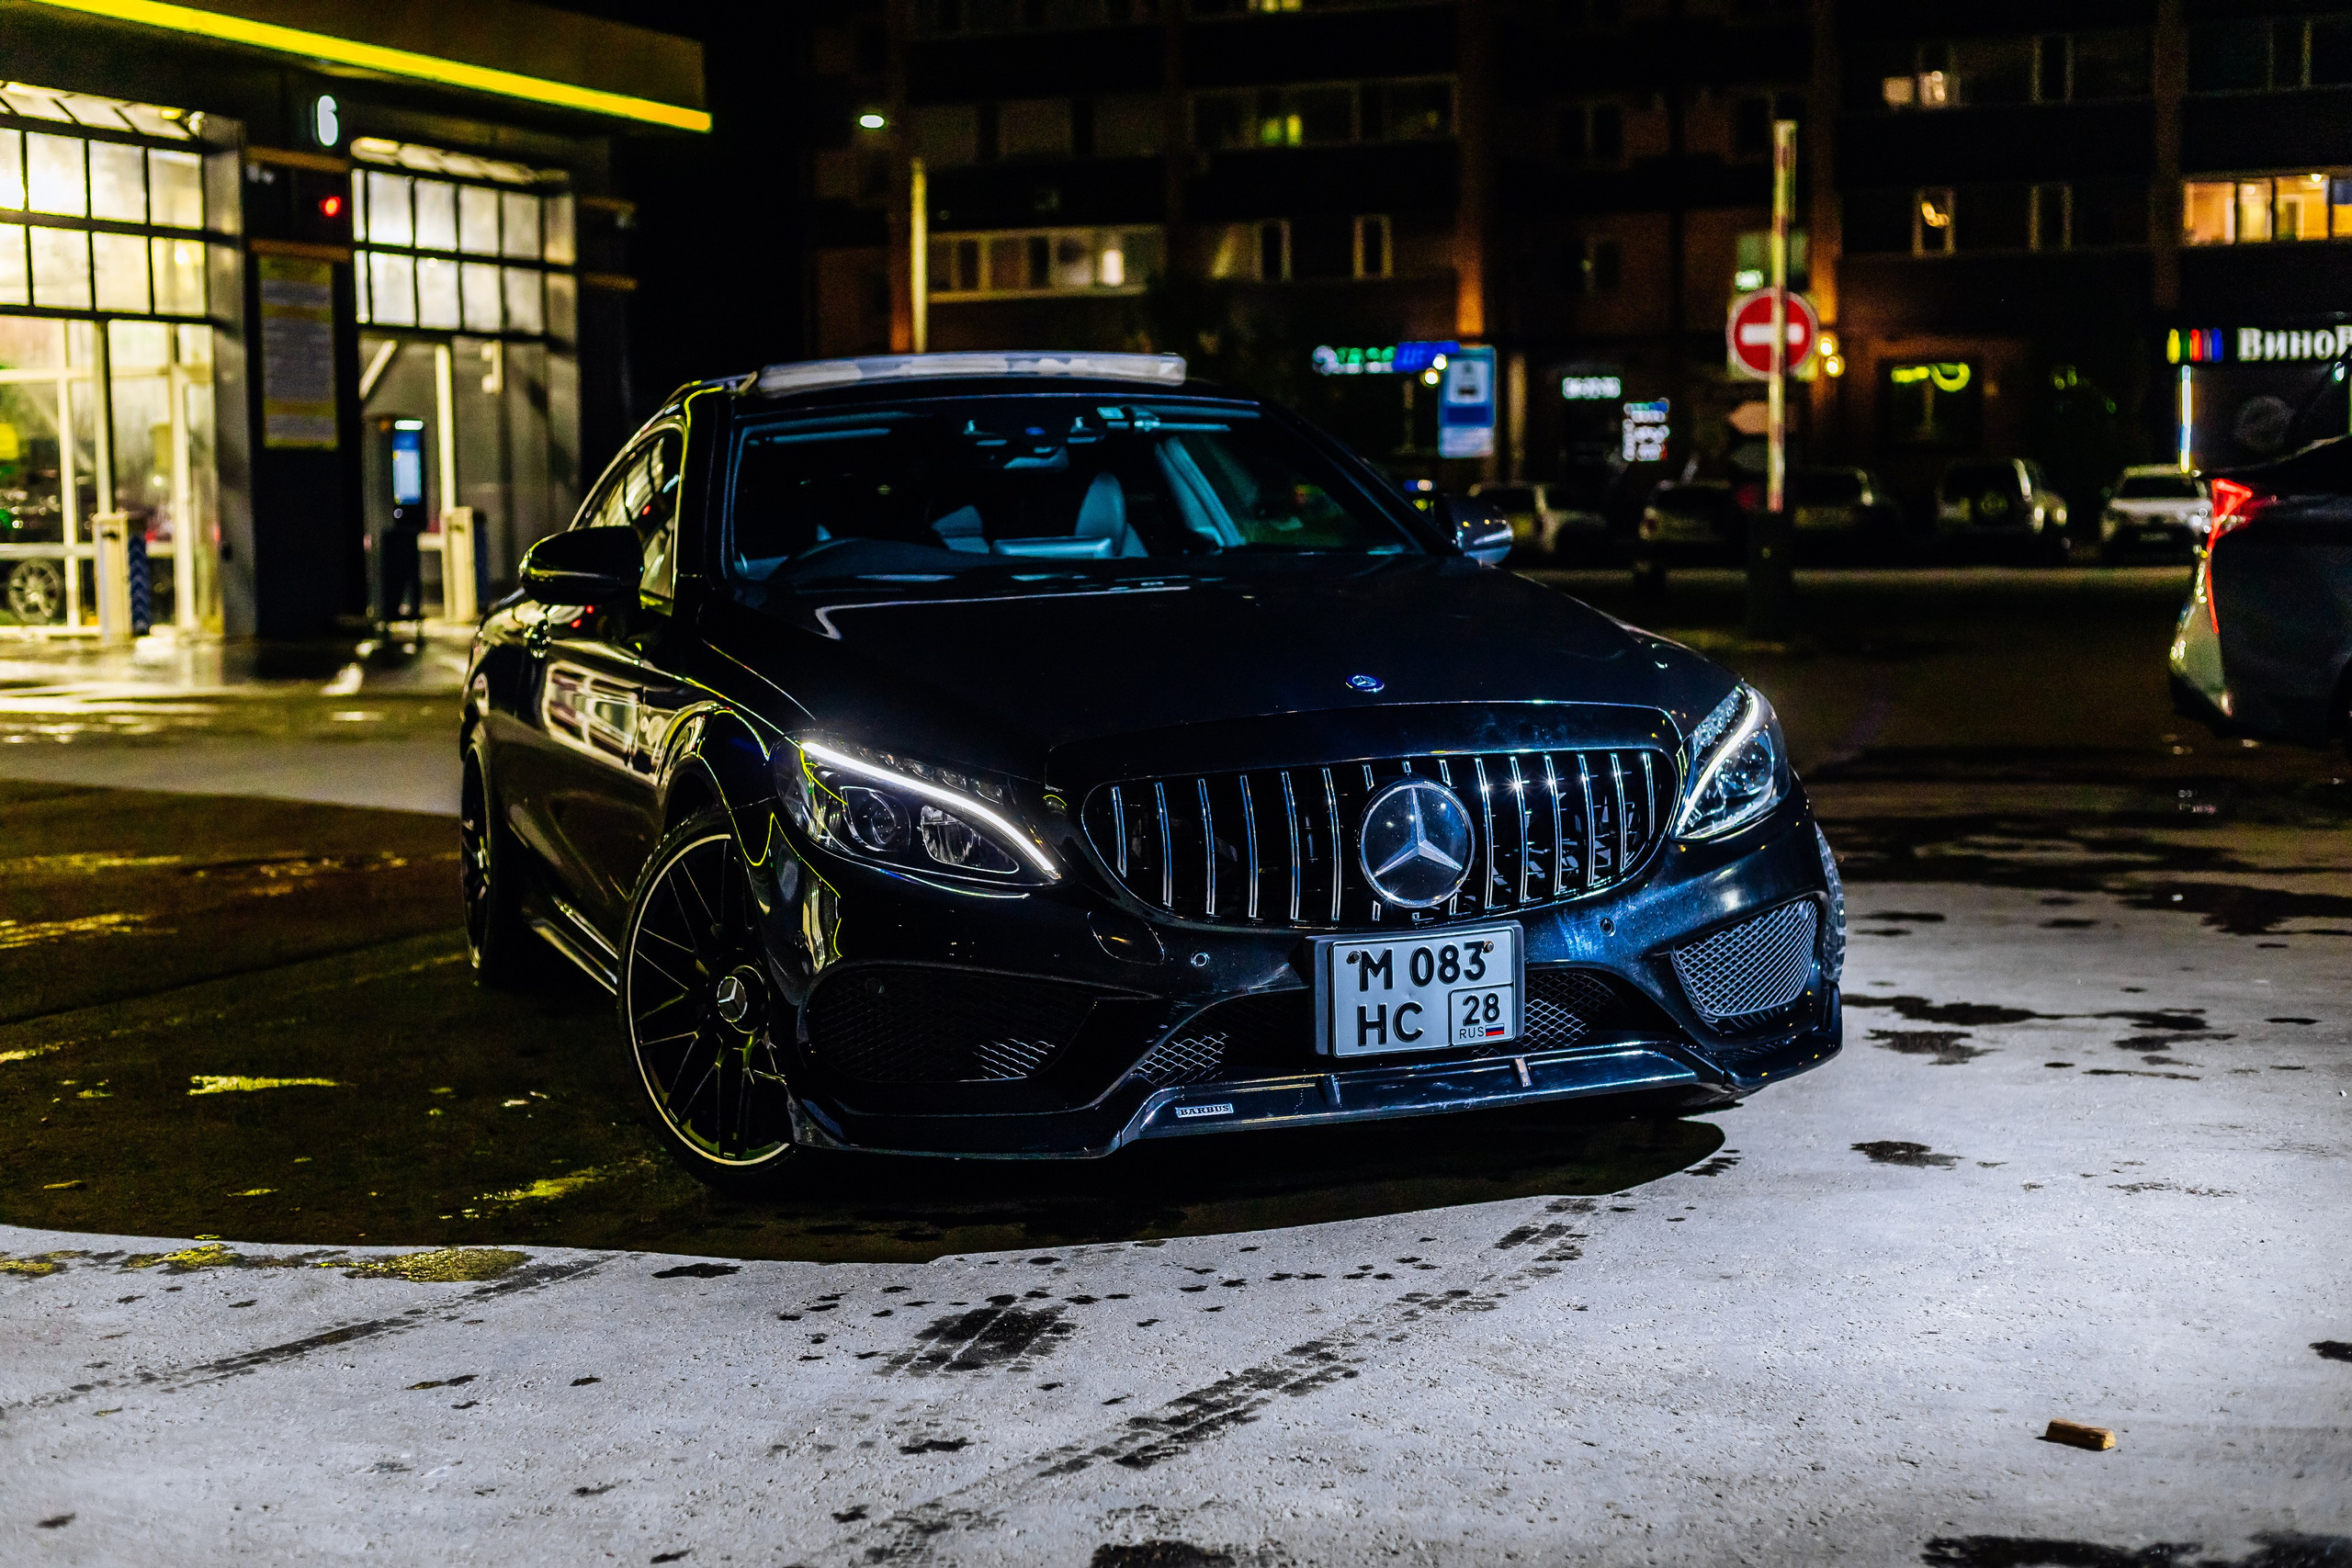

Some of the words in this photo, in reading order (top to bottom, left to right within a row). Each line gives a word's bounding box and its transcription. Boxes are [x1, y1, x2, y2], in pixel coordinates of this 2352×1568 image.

[317, 95, 338, 147] 6
[1409, 940, 1486, 987] 083
[1463, 992, 1500, 1026] 28
[1459, 1026, 1485, 1040] RUS
